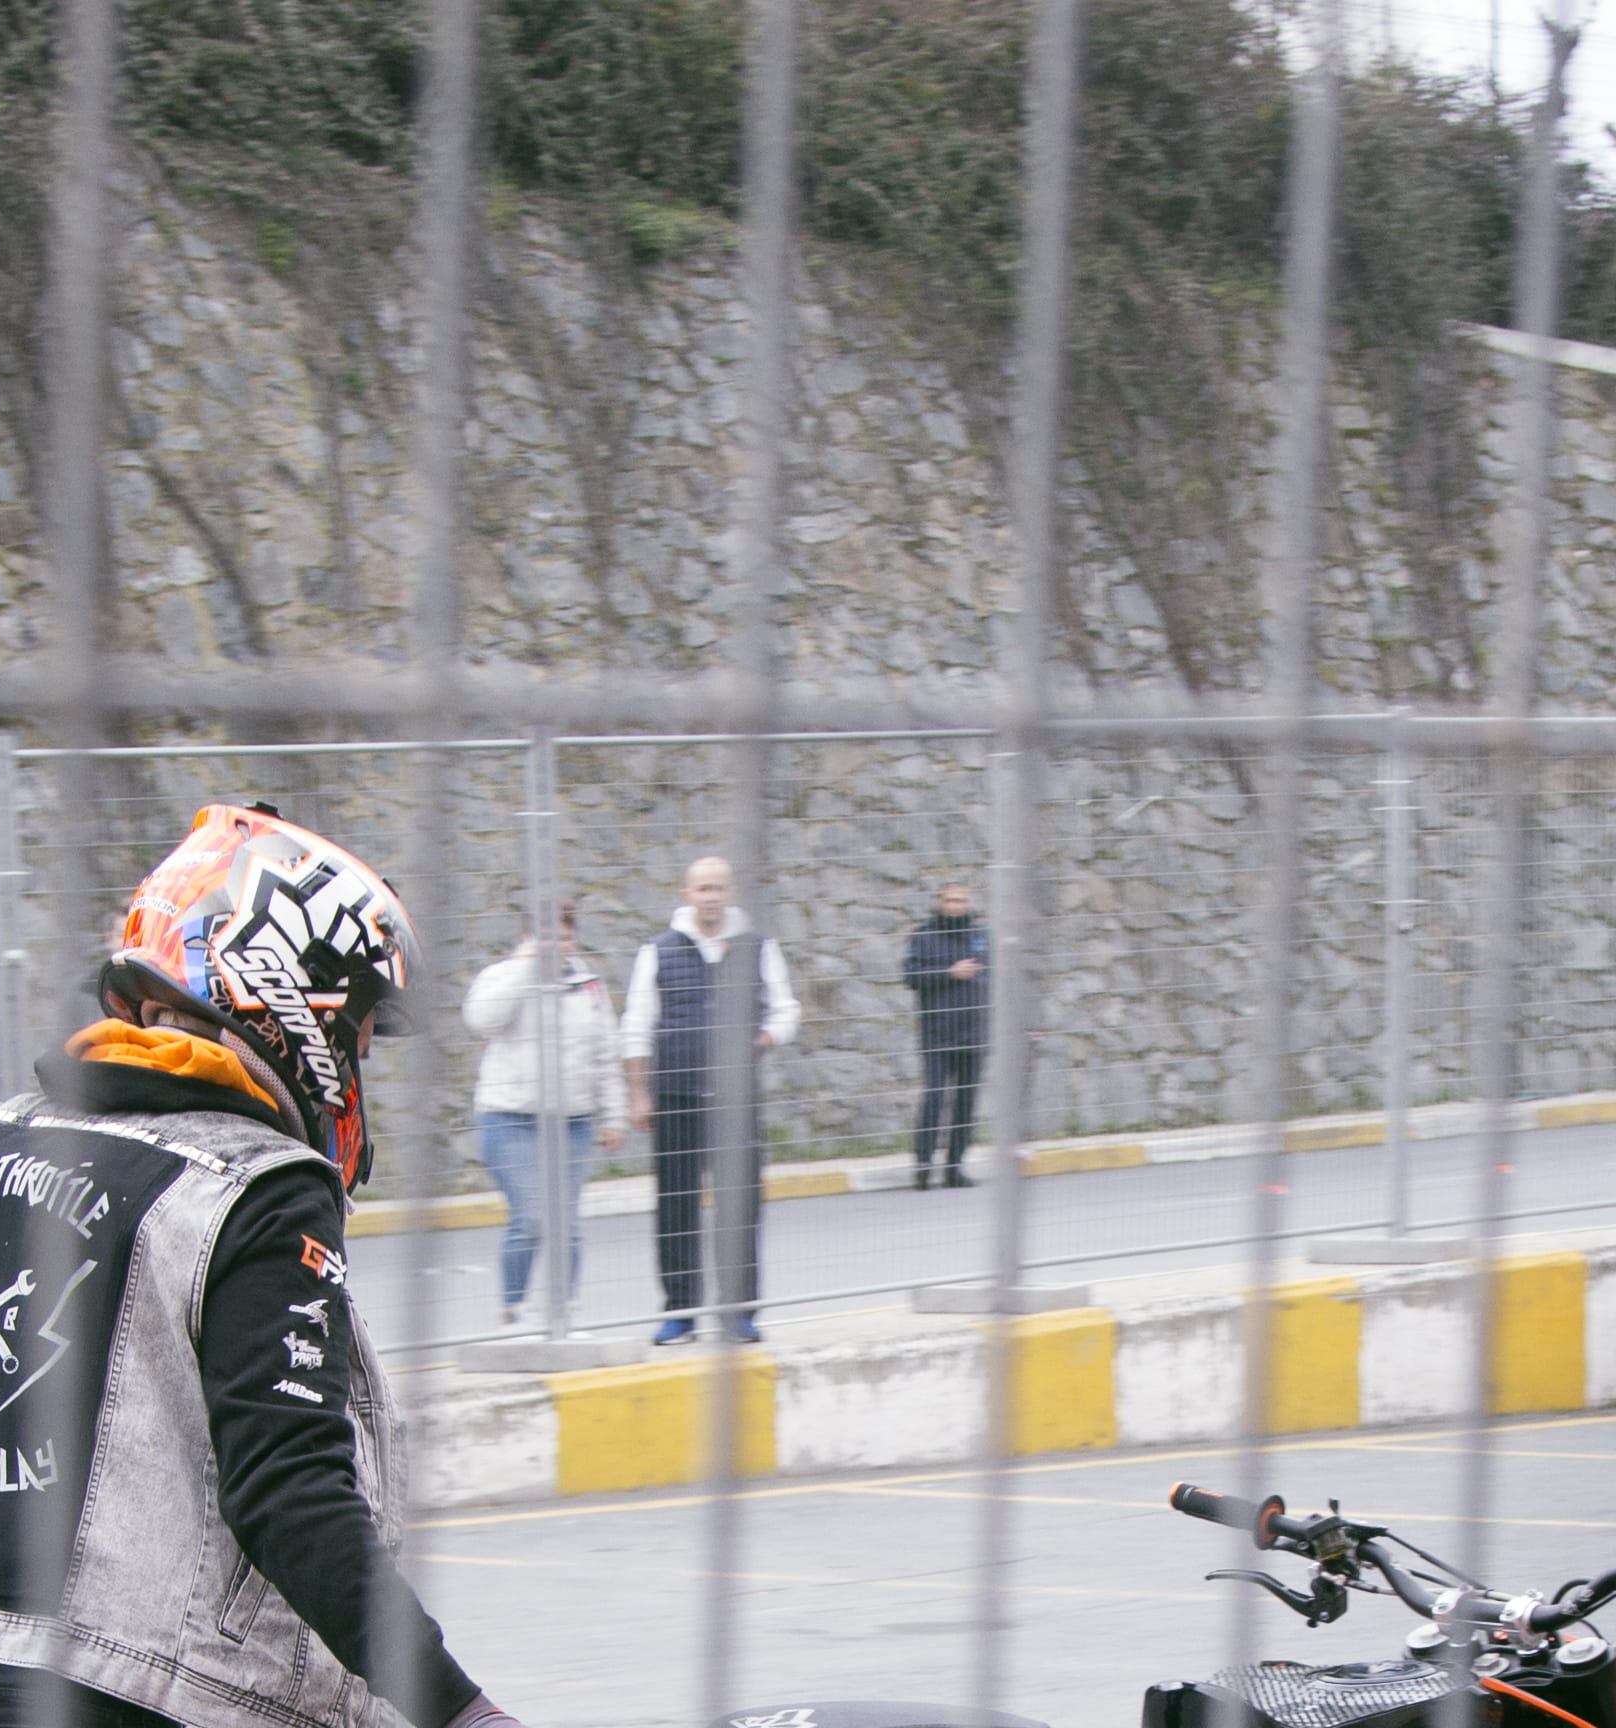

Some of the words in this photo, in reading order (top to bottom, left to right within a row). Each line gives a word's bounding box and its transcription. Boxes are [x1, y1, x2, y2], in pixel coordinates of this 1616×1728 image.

[223, 949, 345, 1109] SCORPION
[3, 1305, 19, 1332] B
[290, 1351, 325, 1371] PARTS
